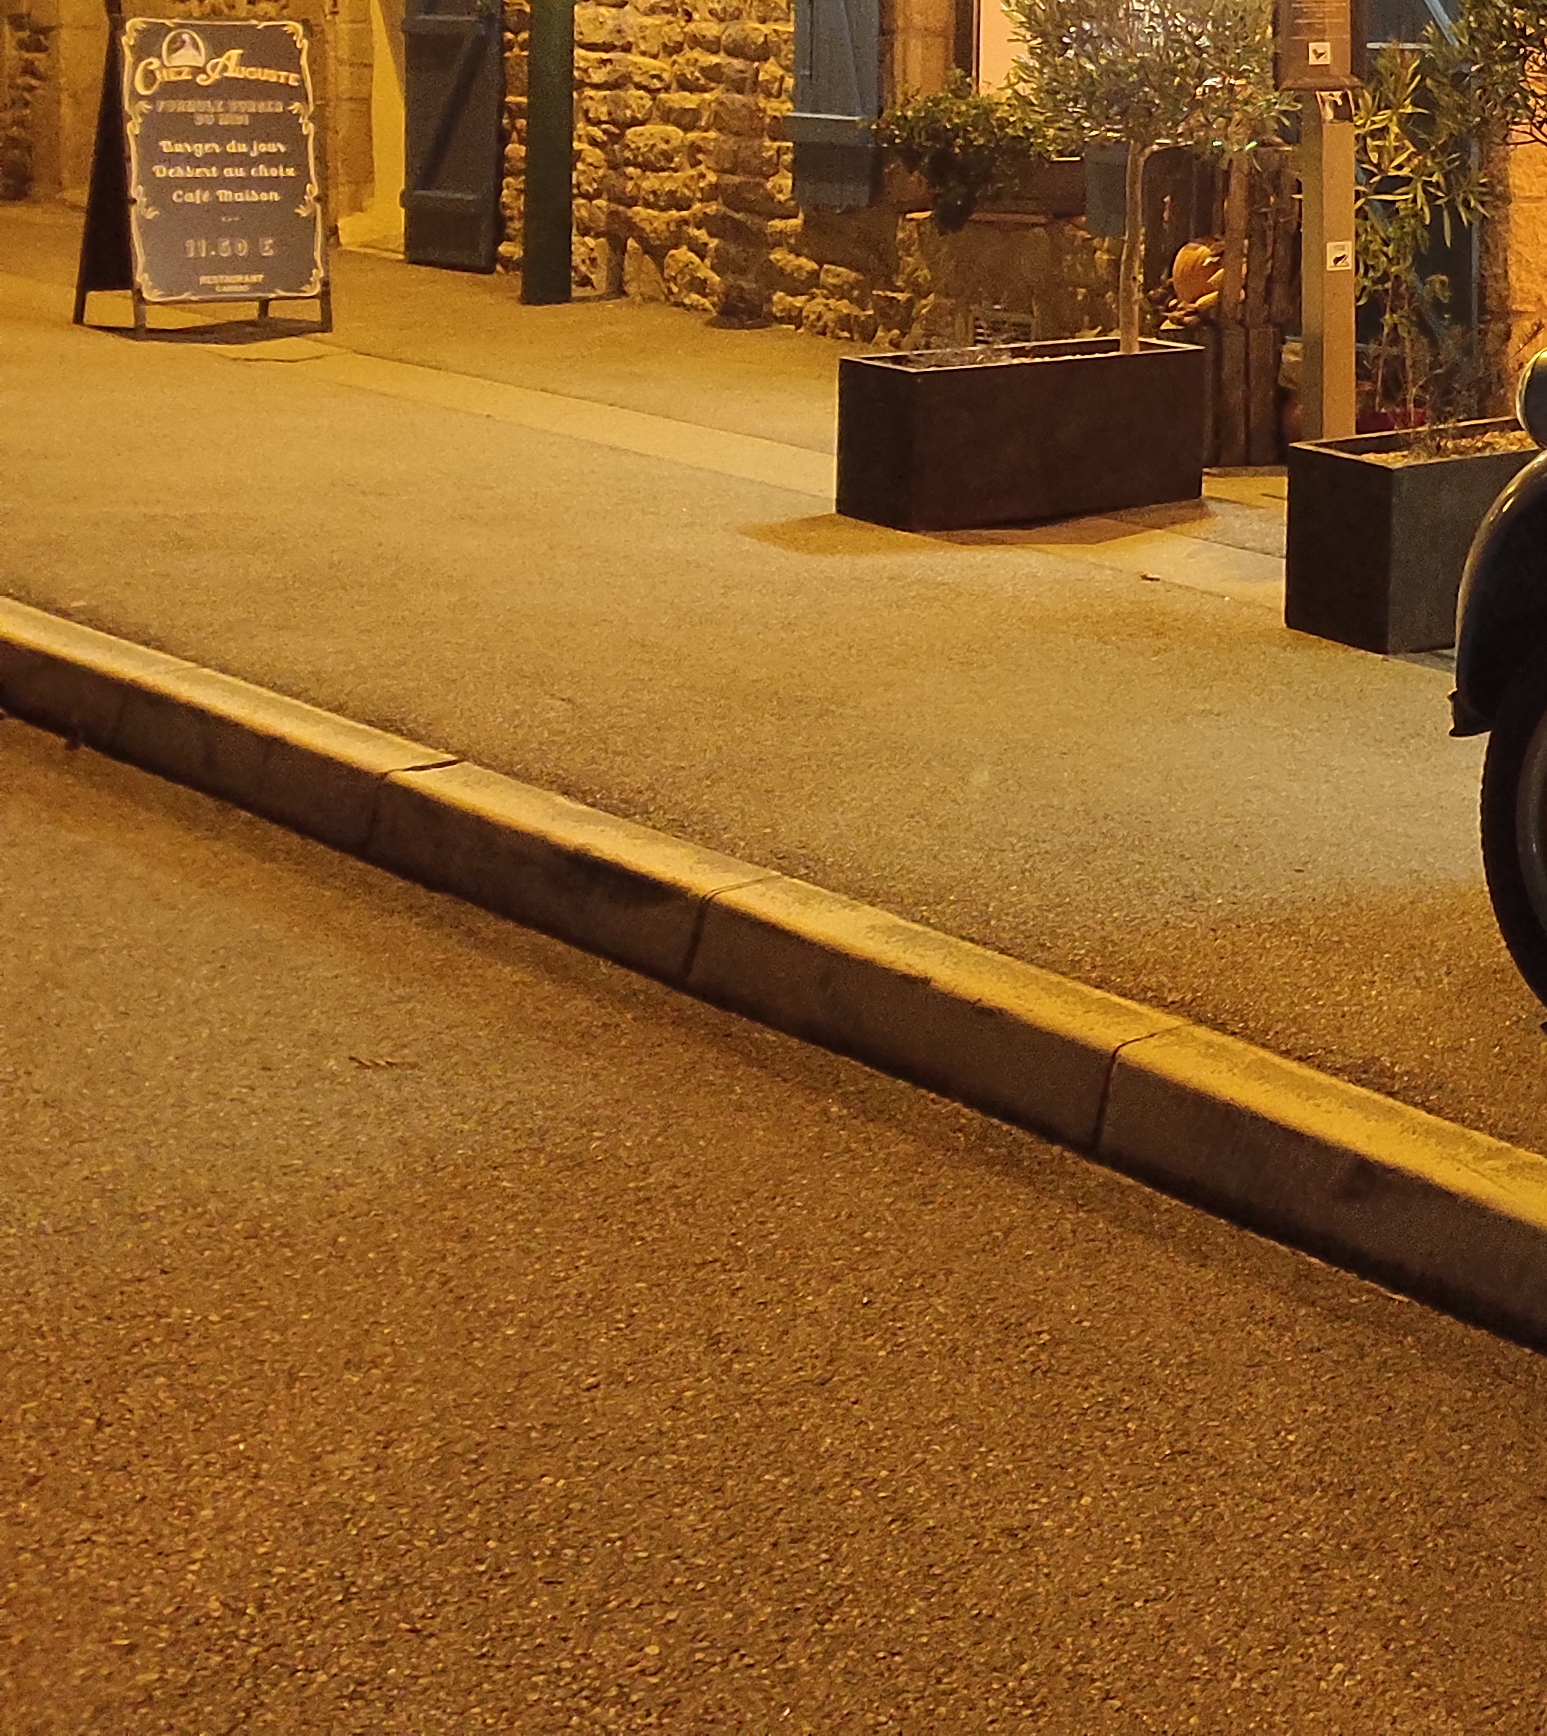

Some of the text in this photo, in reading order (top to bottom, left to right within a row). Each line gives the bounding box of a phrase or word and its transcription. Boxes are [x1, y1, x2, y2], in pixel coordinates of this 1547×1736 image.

[134, 48, 300, 96] CHEZ AUGUSTE
[158, 139, 287, 157] Burger du jour
[223, 165, 246, 178] au
[250, 164, 296, 178] choix
[172, 189, 281, 204] Café Maison
